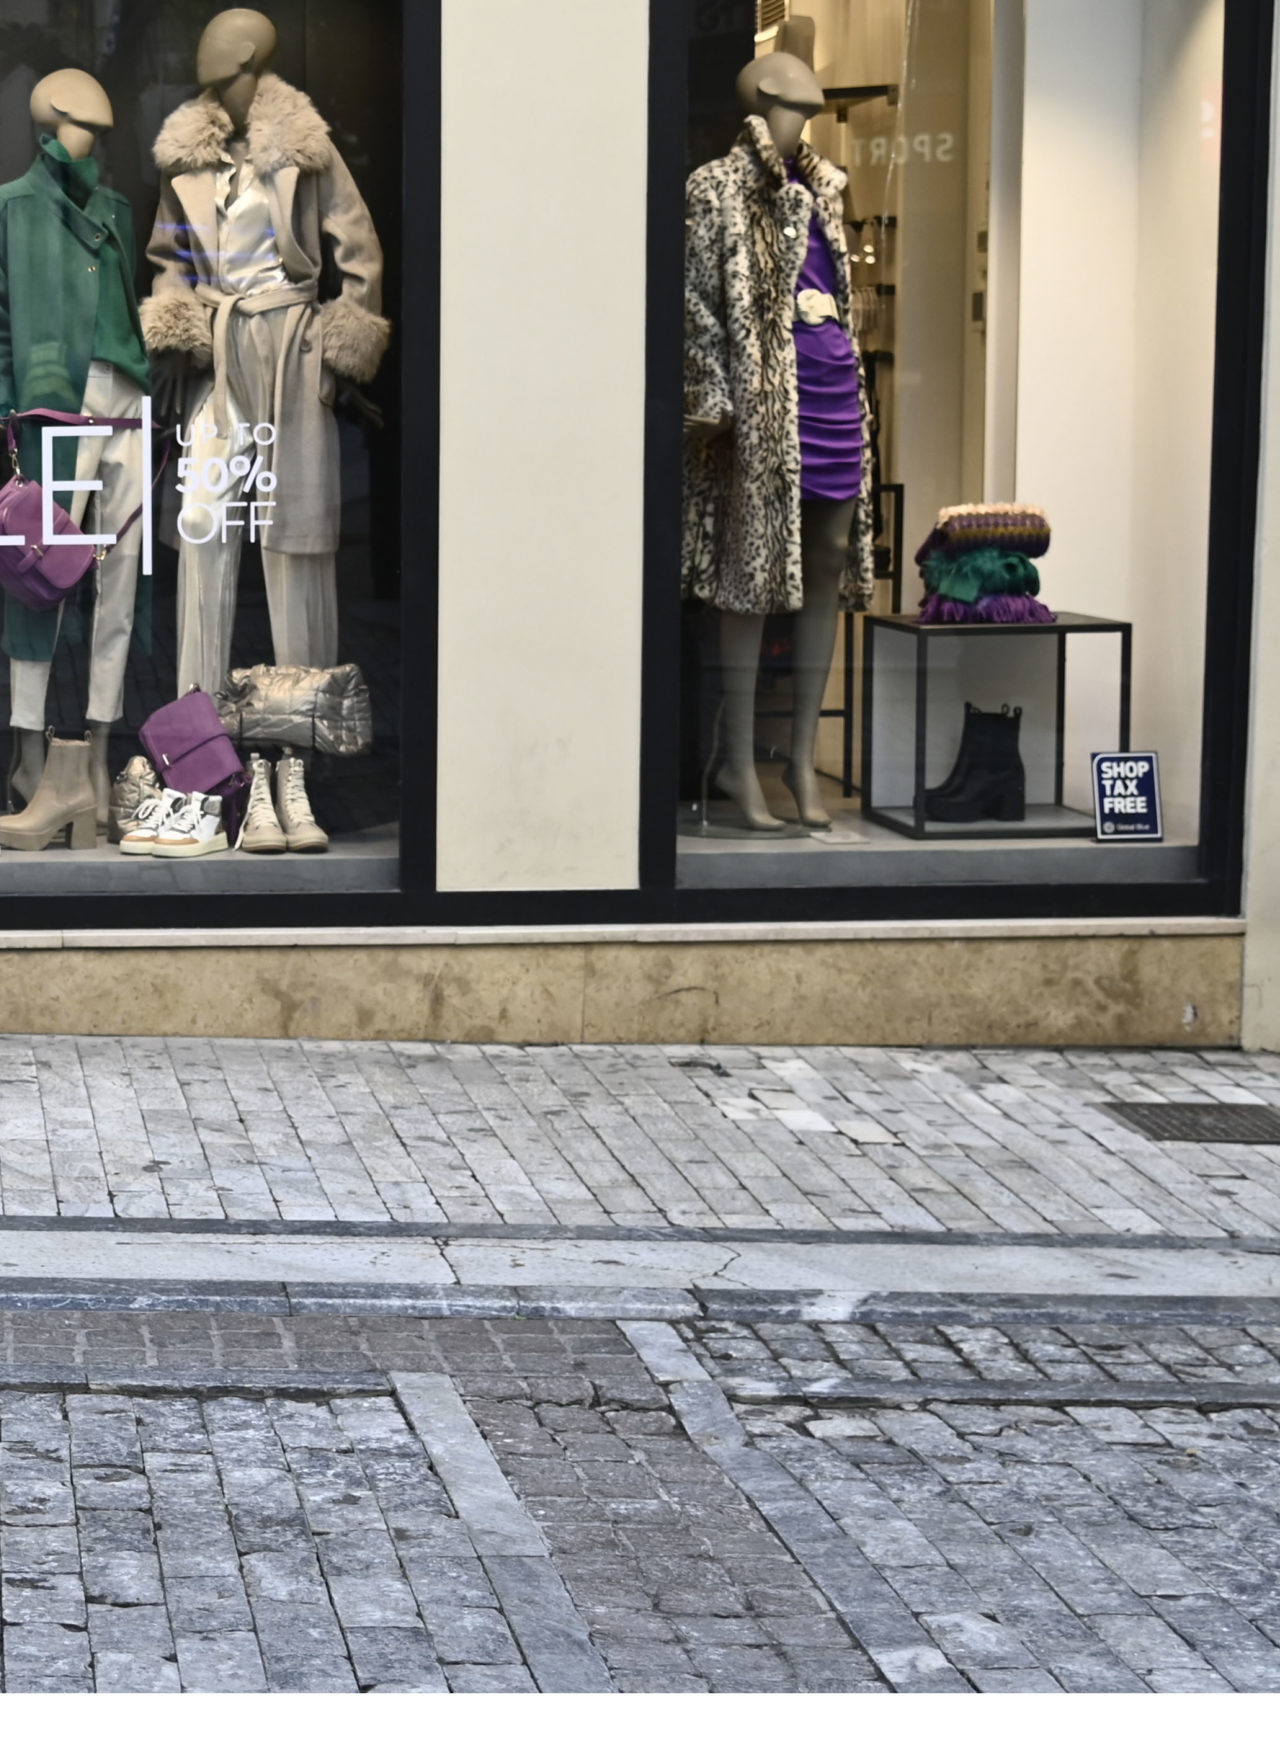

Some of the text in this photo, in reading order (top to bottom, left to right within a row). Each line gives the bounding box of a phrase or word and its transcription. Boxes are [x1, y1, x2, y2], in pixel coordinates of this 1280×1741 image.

[176, 422, 277, 446] UP TO
[175, 455, 277, 494] 50%
[177, 501, 277, 544] OFF
[1100, 761, 1150, 779] SHOP
[1101, 779, 1139, 796] TAX
[1103, 796, 1148, 814] FREE
